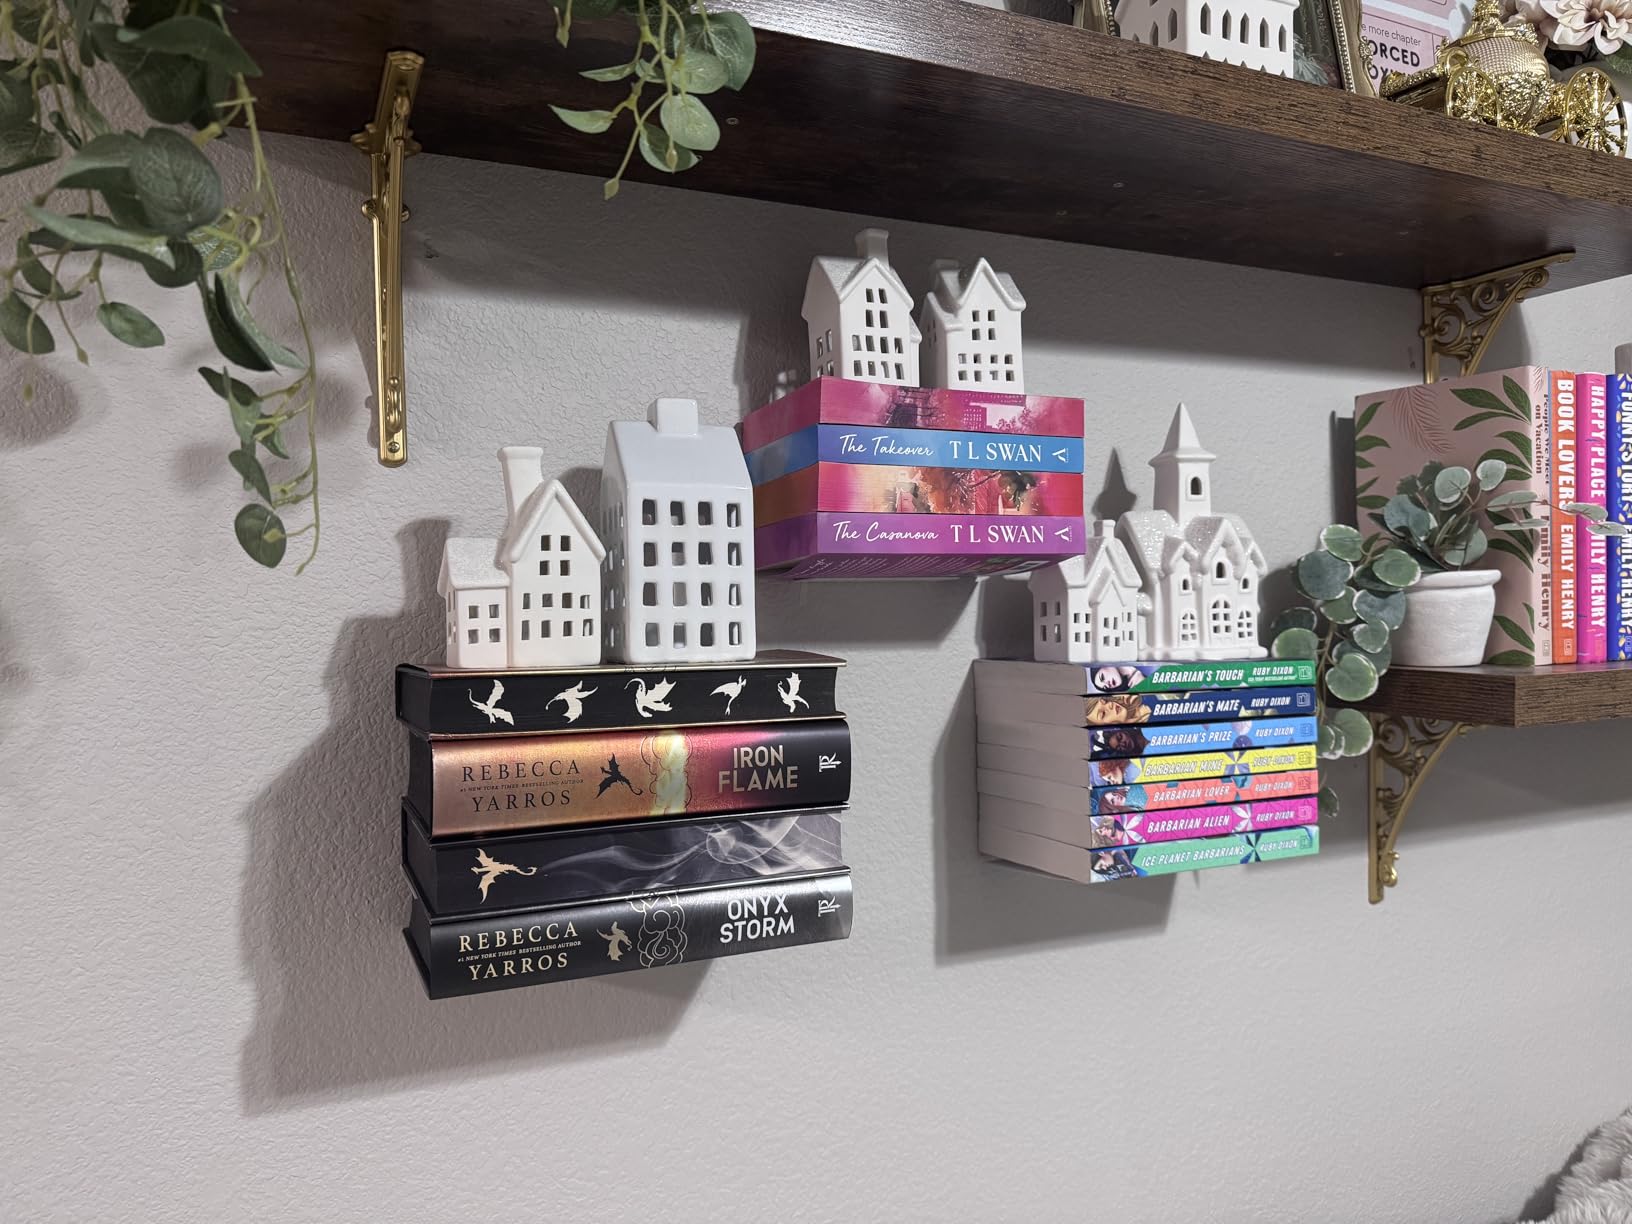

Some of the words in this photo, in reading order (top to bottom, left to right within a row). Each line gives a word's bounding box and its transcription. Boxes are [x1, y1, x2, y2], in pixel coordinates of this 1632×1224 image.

[1369, 26, 1390, 38] more
[1392, 30, 1422, 46] chapter
[1367, 40, 1420, 67] ORCED
[1536, 404, 1541, 420] on
[1557, 379, 1574, 432] BOOK
[1591, 386, 1606, 440] HAPPY
[840, 434, 866, 455] The
[872, 436, 935, 456] Takeover
[949, 440, 962, 460] T
[968, 442, 979, 460] L
[986, 442, 1041, 463] SWAN
[1590, 446, 1606, 498] PLACE
[833, 521, 861, 543] The
[866, 522, 939, 542] Casanova
[950, 525, 963, 543] T
[970, 525, 981, 543] L
[987, 525, 1044, 544] SWAN
[1560, 524, 1574, 572] EMILY
[1538, 574, 1550, 631] Henry
[1561, 578, 1574, 630] HENRY
[1591, 573, 1606, 627] HENRY
[1152, 669, 1212, 684] BARBARIAN'S
[1215, 669, 1244, 681] TOUCH
[1253, 667, 1270, 675] RUBY
[1272, 666, 1294, 674] DIXON
[1153, 702, 1213, 715] BARBARIAN'S
[1216, 700, 1240, 711] MATE
[1251, 698, 1269, 707] RUBY
[1270, 696, 1291, 706] DIXON
[1151, 733, 1206, 746] BARBARIAN'S
[1208, 731, 1232, 741] PRIZE
[1256, 729, 1273, 737] RUBY
[1274, 727, 1294, 735] DIXON
[733, 745, 784, 768] IRON
[1145, 762, 1198, 776] BARBARIAN
[1200, 759, 1223, 771] MINE
[462, 760, 580, 782] REBECCA
[718, 766, 798, 793] FLAME
[1153, 788, 1201, 802] BARBARIAN
[1204, 786, 1230, 797] LOVER
[1255, 783, 1272, 792] RUBY
[1273, 782, 1293, 790] DIXON
[472, 790, 570, 812] YARROS
[1148, 818, 1201, 833] BARBARIAN
[1203, 815, 1230, 828] ALIEN
[1256, 813, 1274, 822] RUBY
[1275, 811, 1295, 820] DIXON
[1142, 856, 1155, 867] ICE
[1158, 851, 1191, 865] PLANET
[1193, 845, 1245, 861] BARBARIANS
[1260, 843, 1277, 851] RUBY
[1278, 840, 1297, 849] DIXON
[728, 894, 788, 920] ONYX
[459, 921, 578, 952] REBECCA
[720, 915, 794, 943] STORM
[519, 944, 557, 954] BESTSELLING
[558, 941, 581, 949] AUTHOR
[469, 952, 568, 980] YARROS
